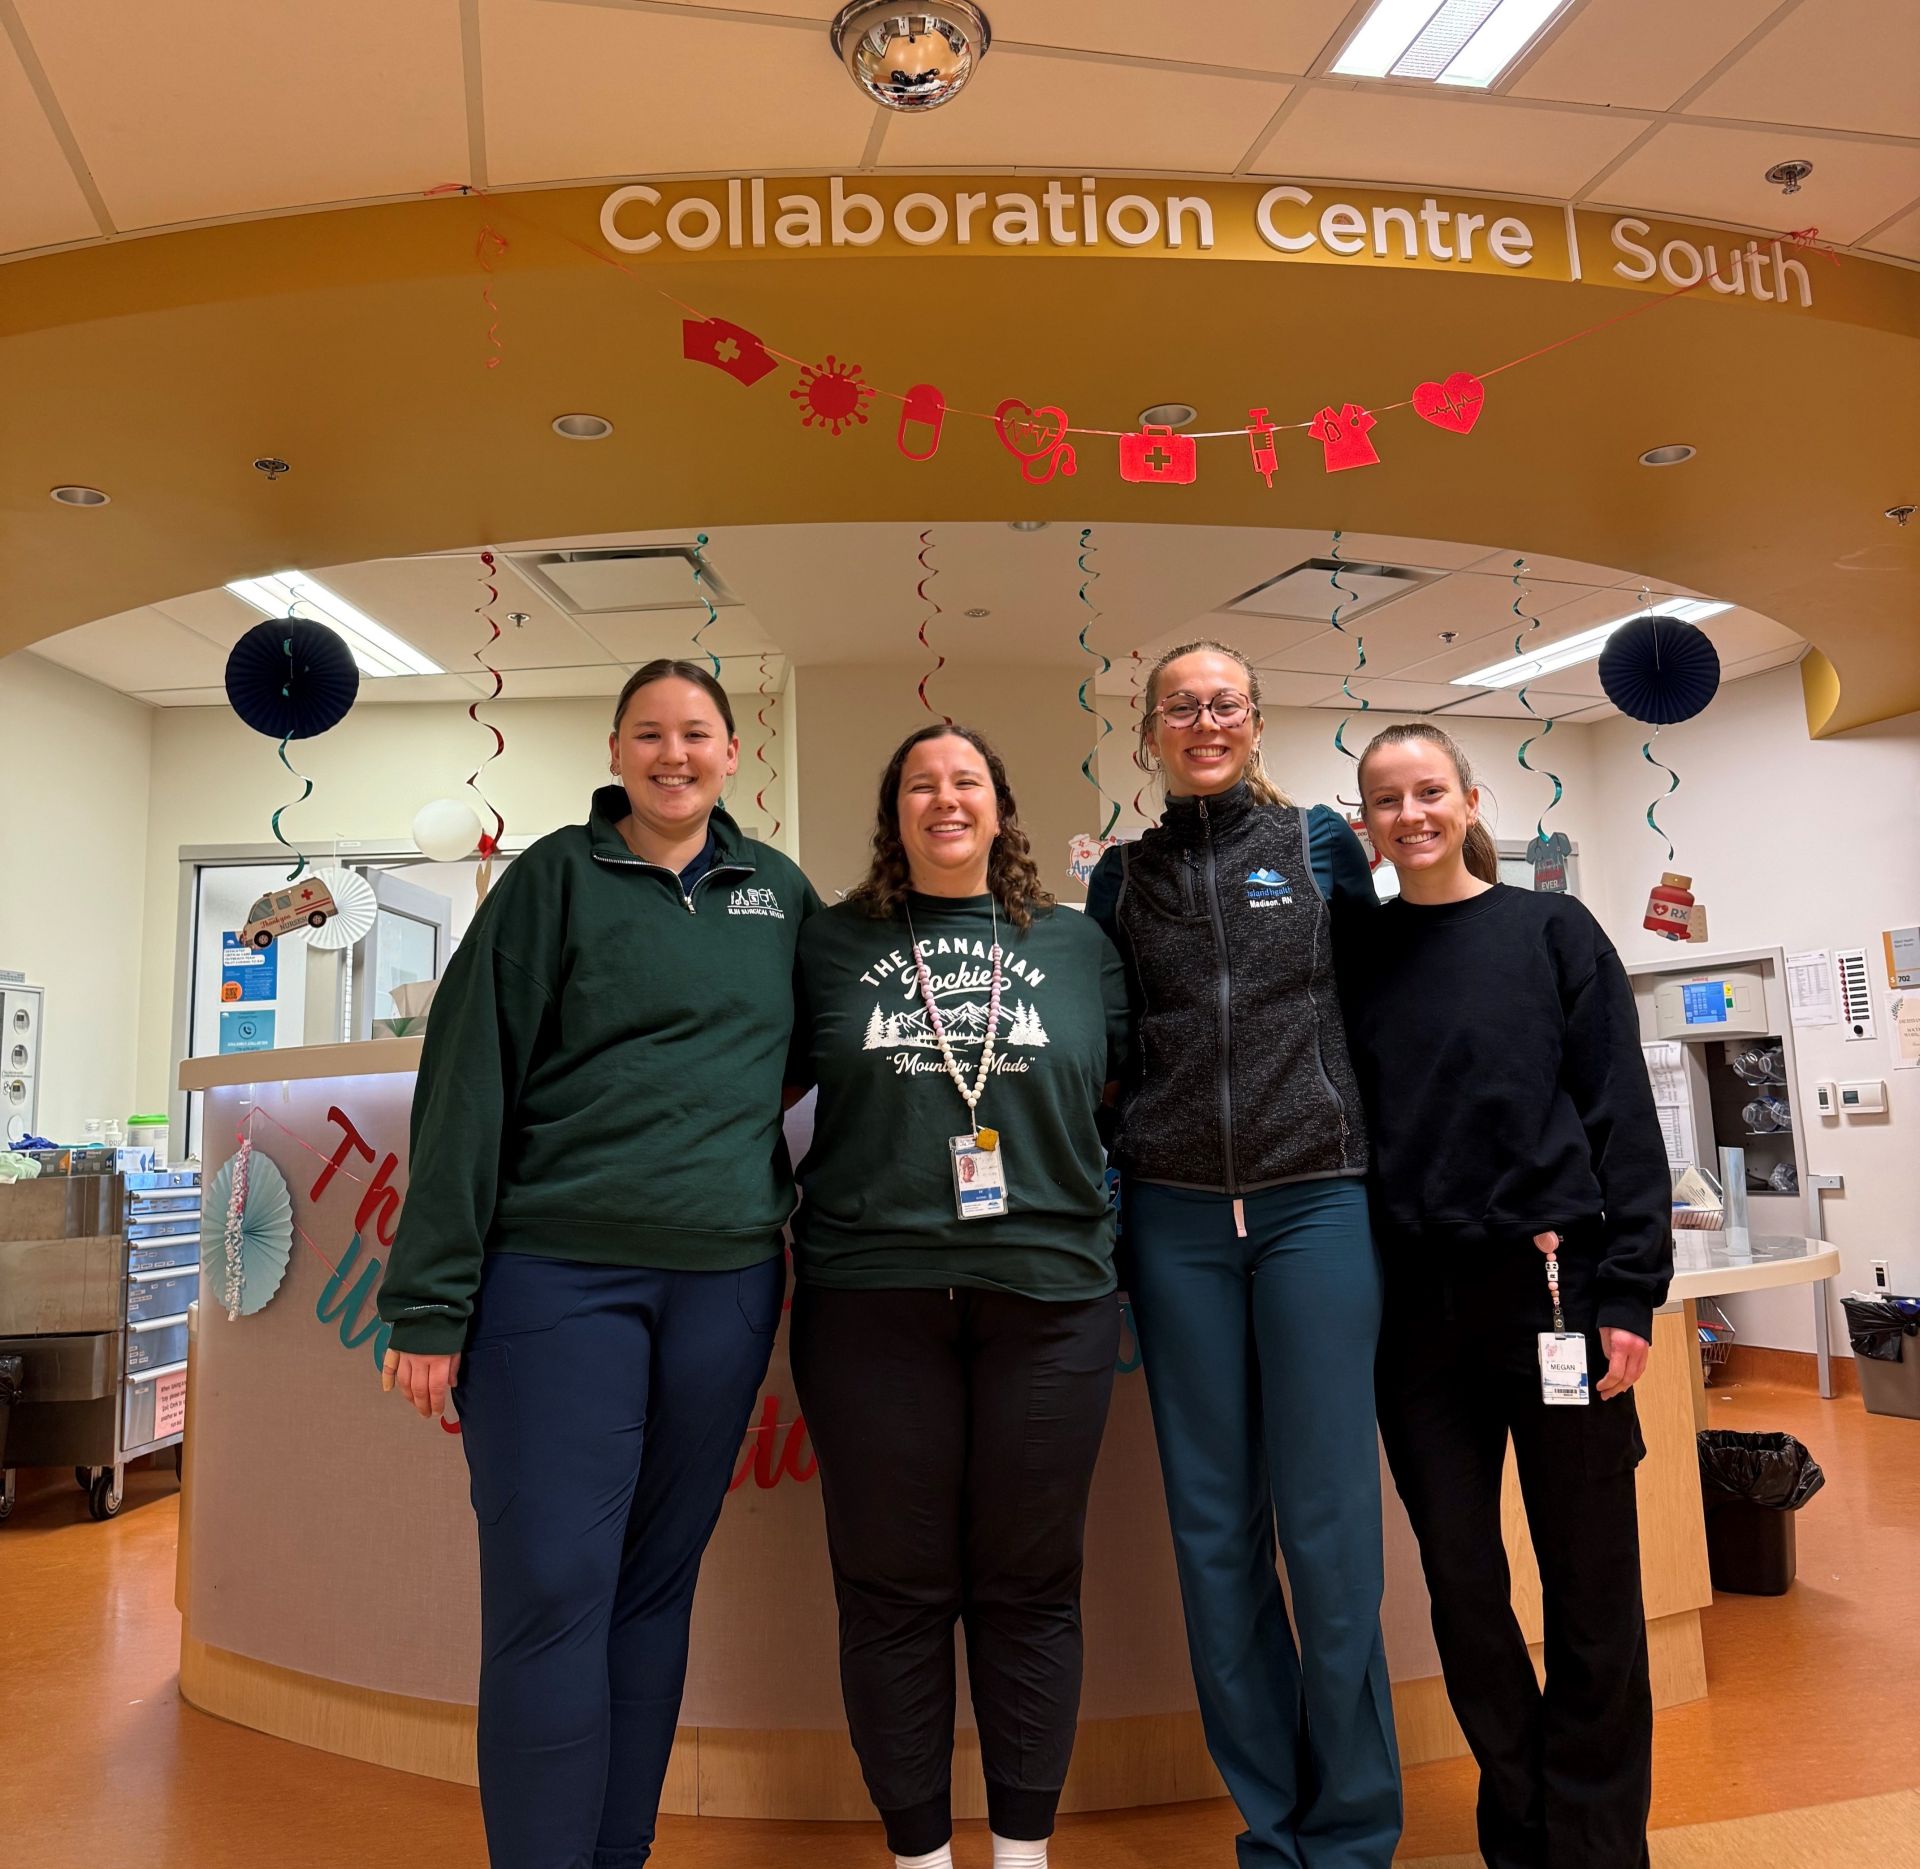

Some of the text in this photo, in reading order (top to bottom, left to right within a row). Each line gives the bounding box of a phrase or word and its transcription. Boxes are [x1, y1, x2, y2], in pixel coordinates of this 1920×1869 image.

[600, 176, 1214, 254] Collaboration
[1255, 185, 1534, 268] Centre
[1611, 217, 1813, 308] South
[1541, 879, 1558, 890] EVER
[1281, 896, 1293, 905] RN
[1670, 908, 1687, 920] RX
[860, 938, 1046, 988] THE CANADIAN
[901, 961, 1011, 1000] Rockie
[1898, 975, 1911, 983] 702
